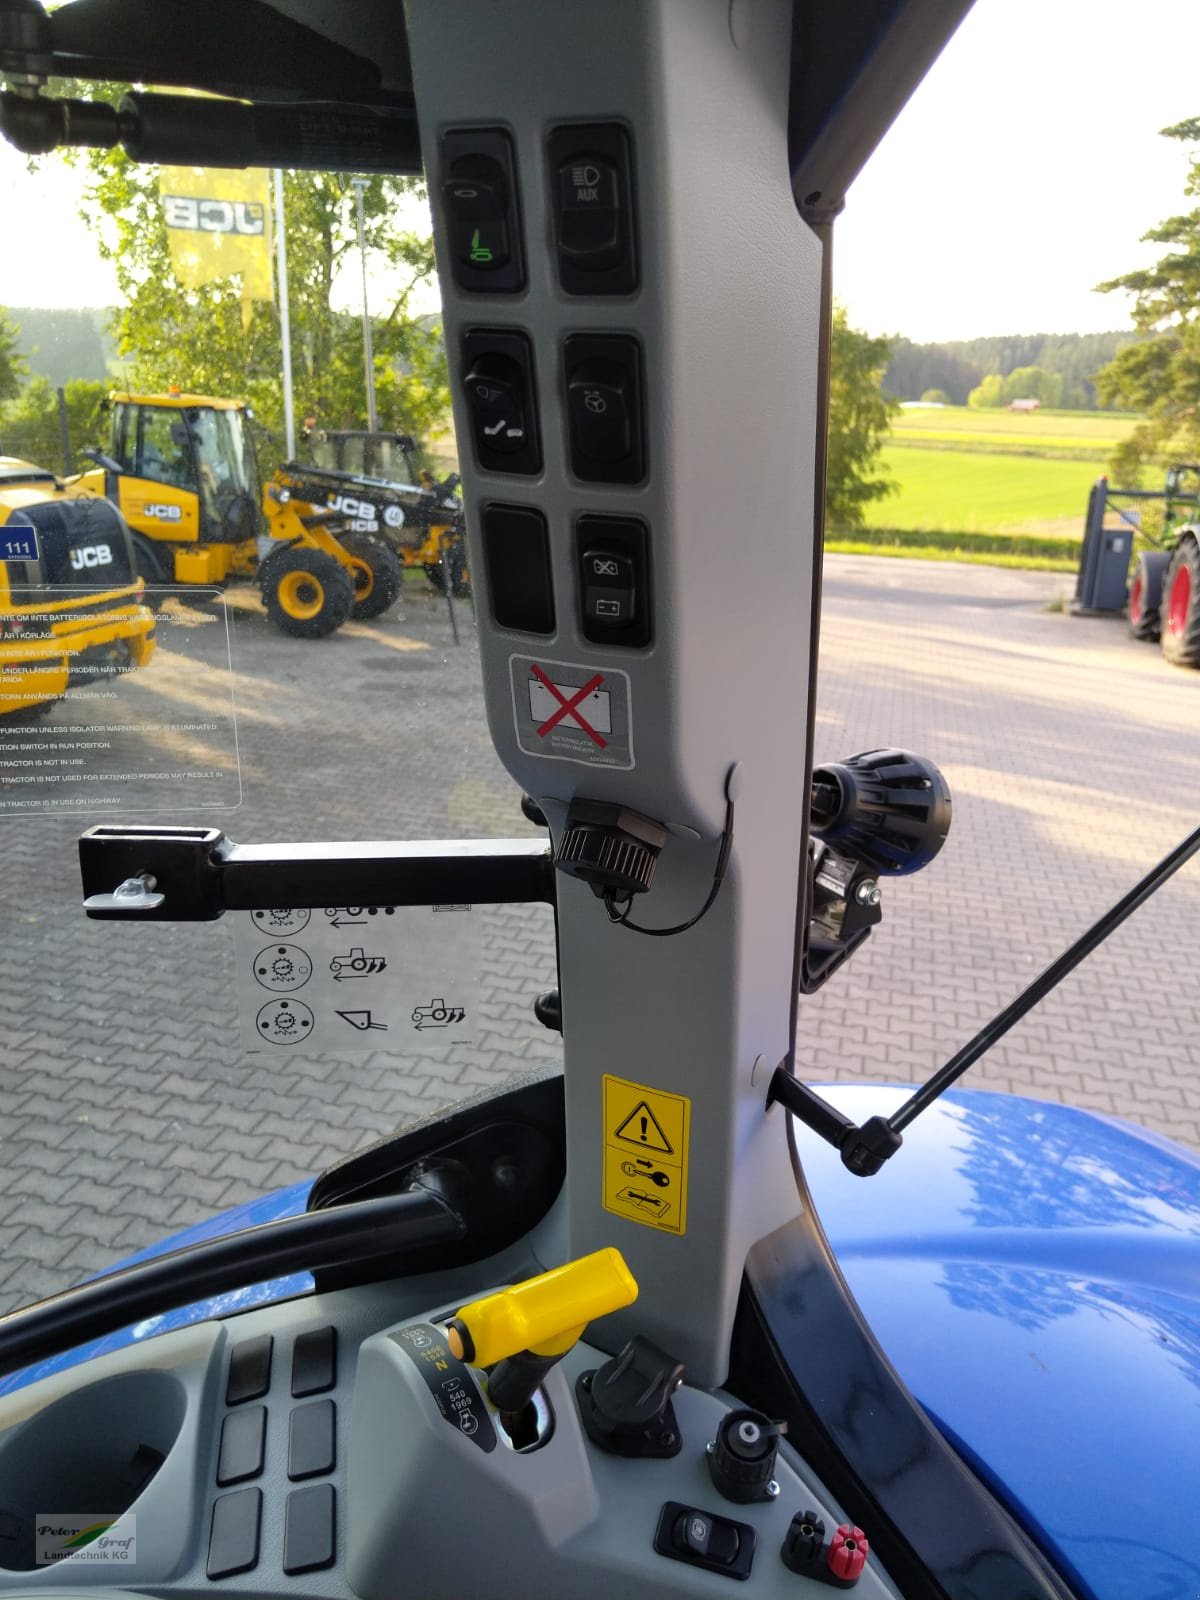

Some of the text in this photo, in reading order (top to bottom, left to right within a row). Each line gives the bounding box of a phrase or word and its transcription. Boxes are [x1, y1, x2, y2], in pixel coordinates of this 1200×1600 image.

[577, 188, 598, 200] AUX
[144, 504, 181, 518] JCB
[327, 494, 376, 520] JCB
[5, 542, 30, 554] 111
[70, 544, 112, 570] JCB
[435, 1360, 448, 1372] N
[449, 1390, 466, 1402] 540
